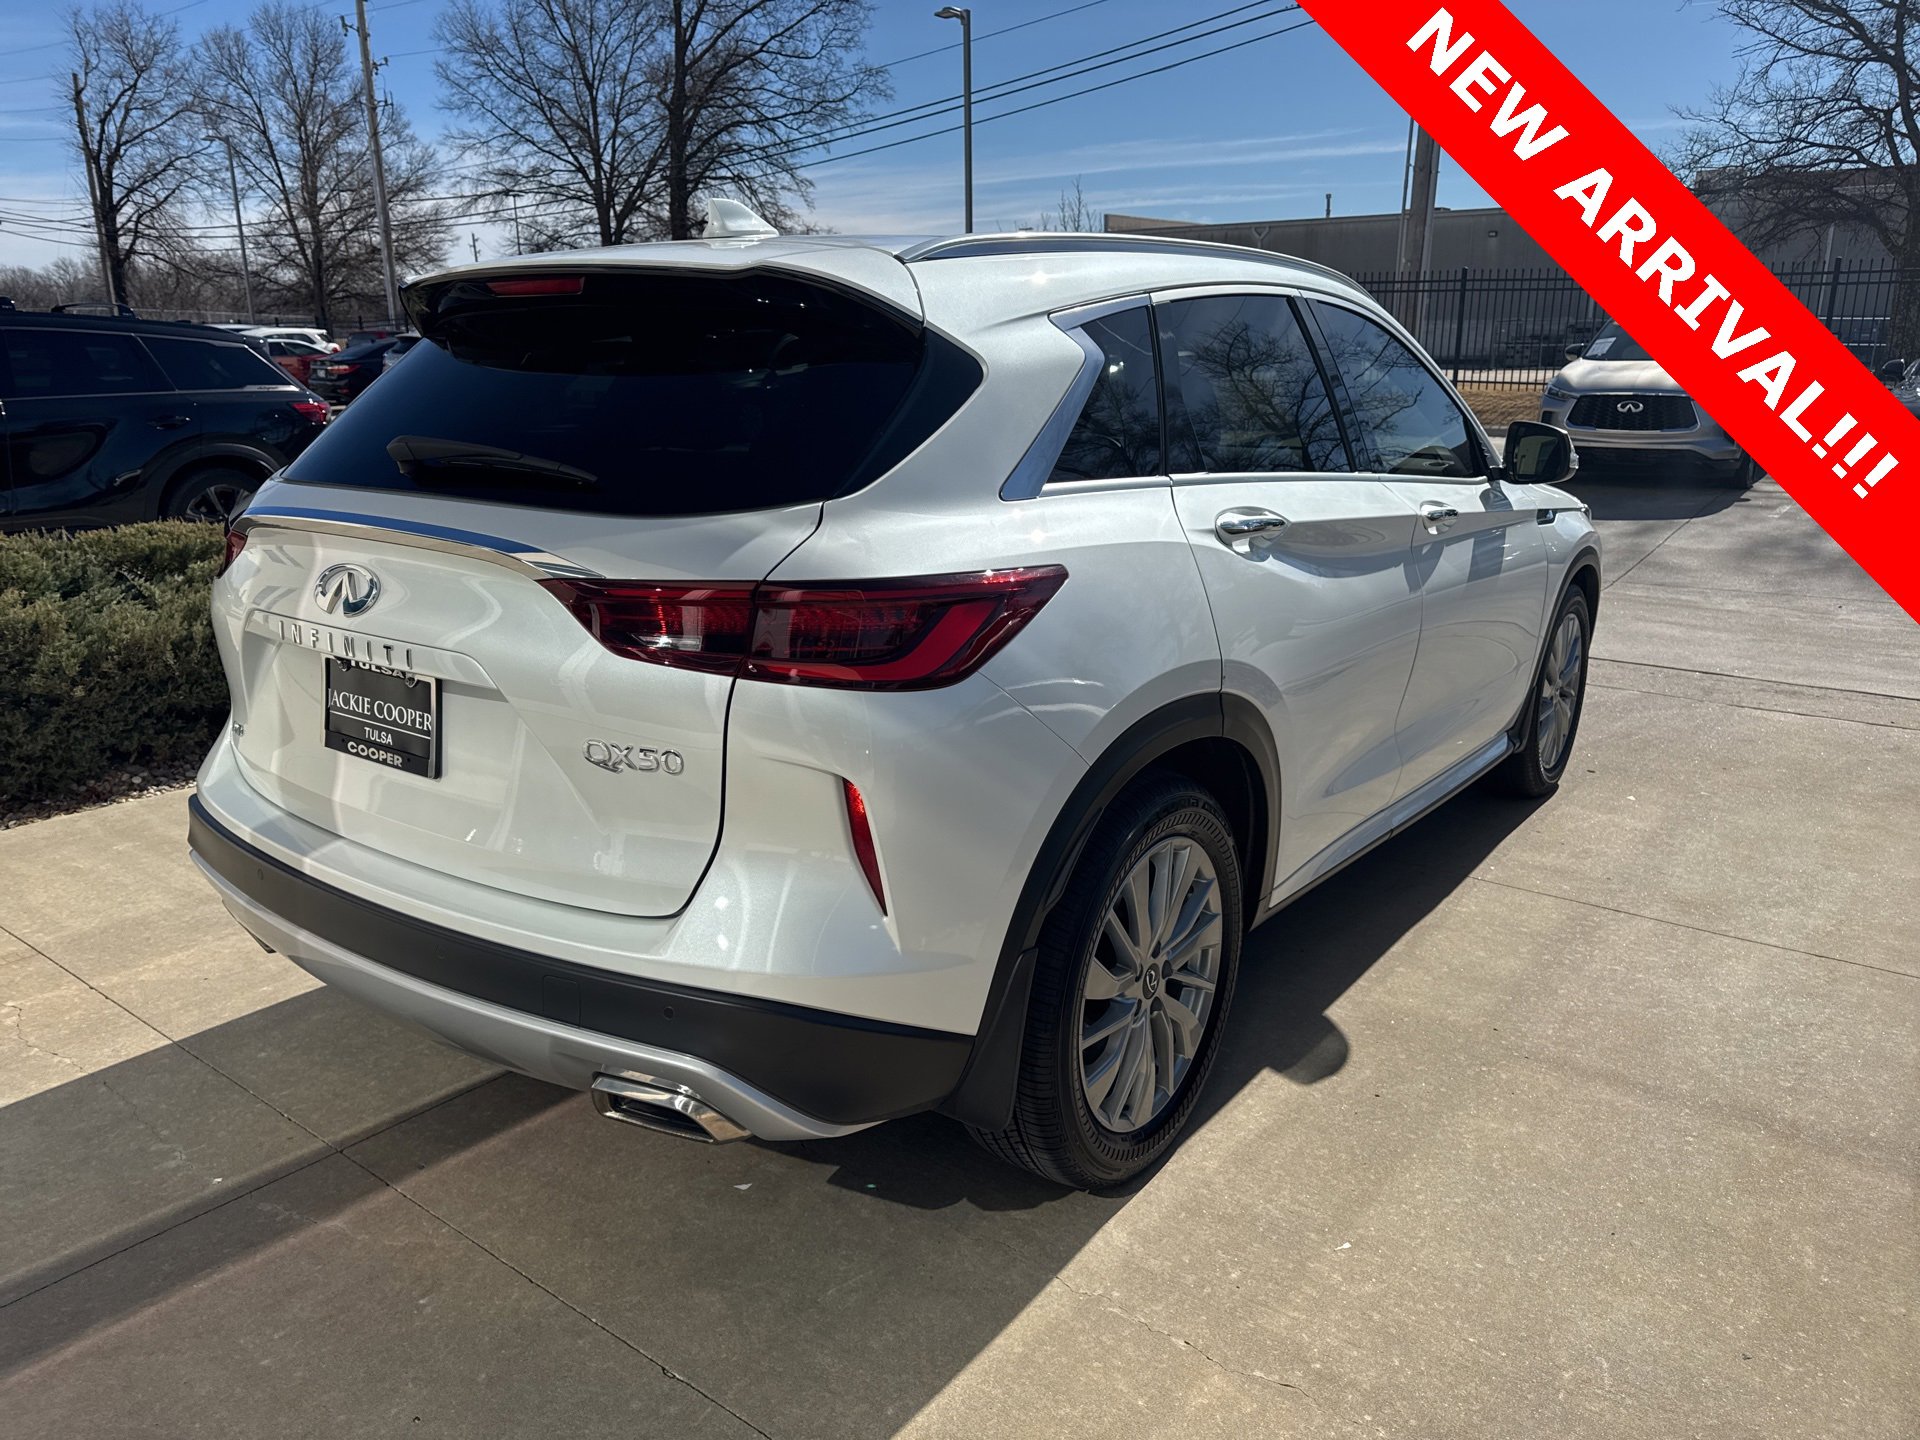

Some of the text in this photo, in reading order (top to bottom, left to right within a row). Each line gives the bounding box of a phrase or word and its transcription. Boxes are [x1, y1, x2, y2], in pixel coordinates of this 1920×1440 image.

[278, 620, 413, 670] INFINITI
[327, 687, 432, 731] JACKIE COOPER
[347, 741, 403, 768] COOPER
[363, 726, 393, 746] TULSA
[582, 739, 684, 776] QX50
